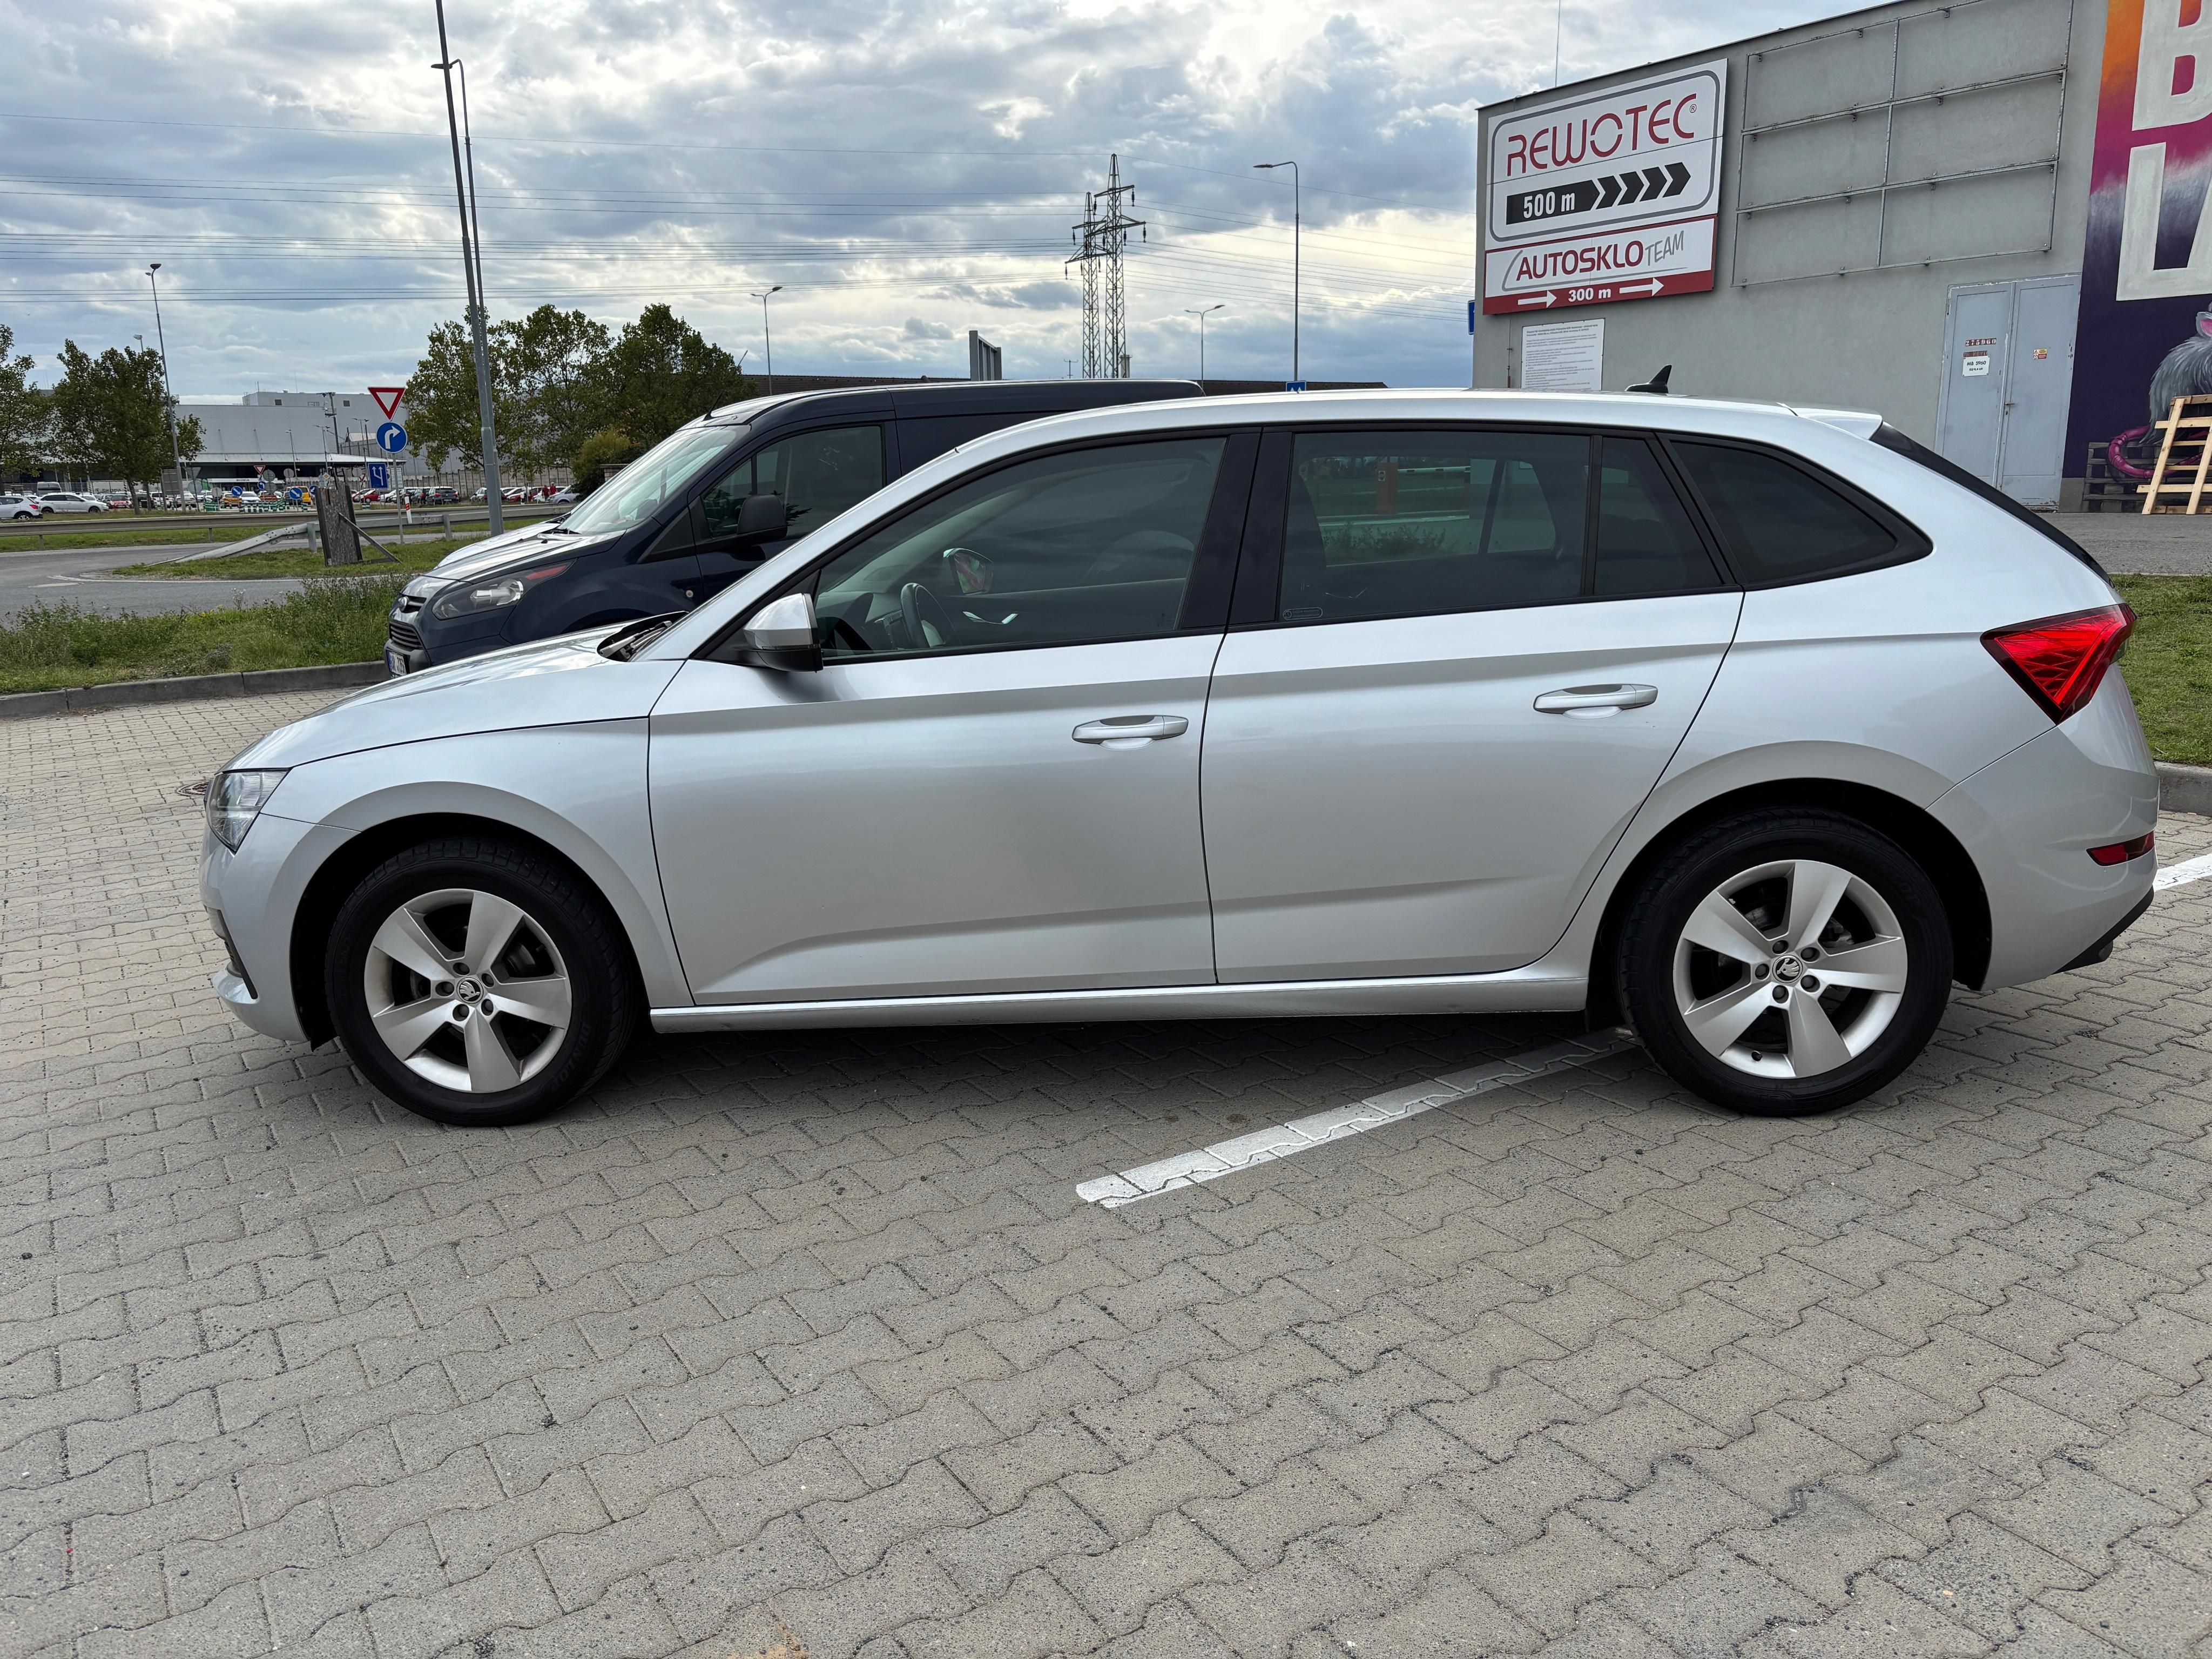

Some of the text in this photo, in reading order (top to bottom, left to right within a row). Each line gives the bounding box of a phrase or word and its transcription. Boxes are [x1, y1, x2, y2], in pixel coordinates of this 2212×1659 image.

[1523, 191, 1575, 219] 500 m
[1516, 231, 1684, 281] AUTOSKLO TEAM
[1568, 288, 1611, 302] 300 m
